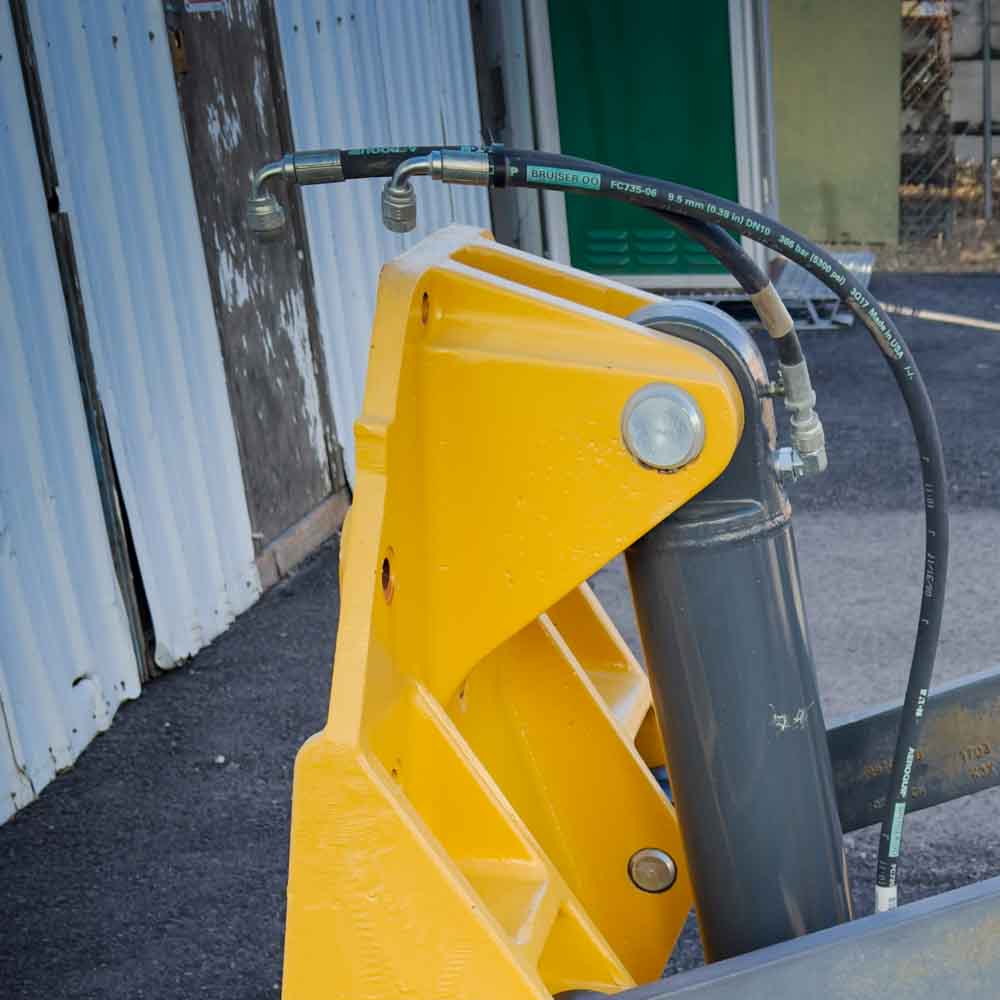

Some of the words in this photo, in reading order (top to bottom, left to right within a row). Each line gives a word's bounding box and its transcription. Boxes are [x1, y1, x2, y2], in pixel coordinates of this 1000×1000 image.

[531, 169, 577, 184] BRUISER
[610, 180, 657, 198] FC735-06
[868, 308, 887, 332] Made
